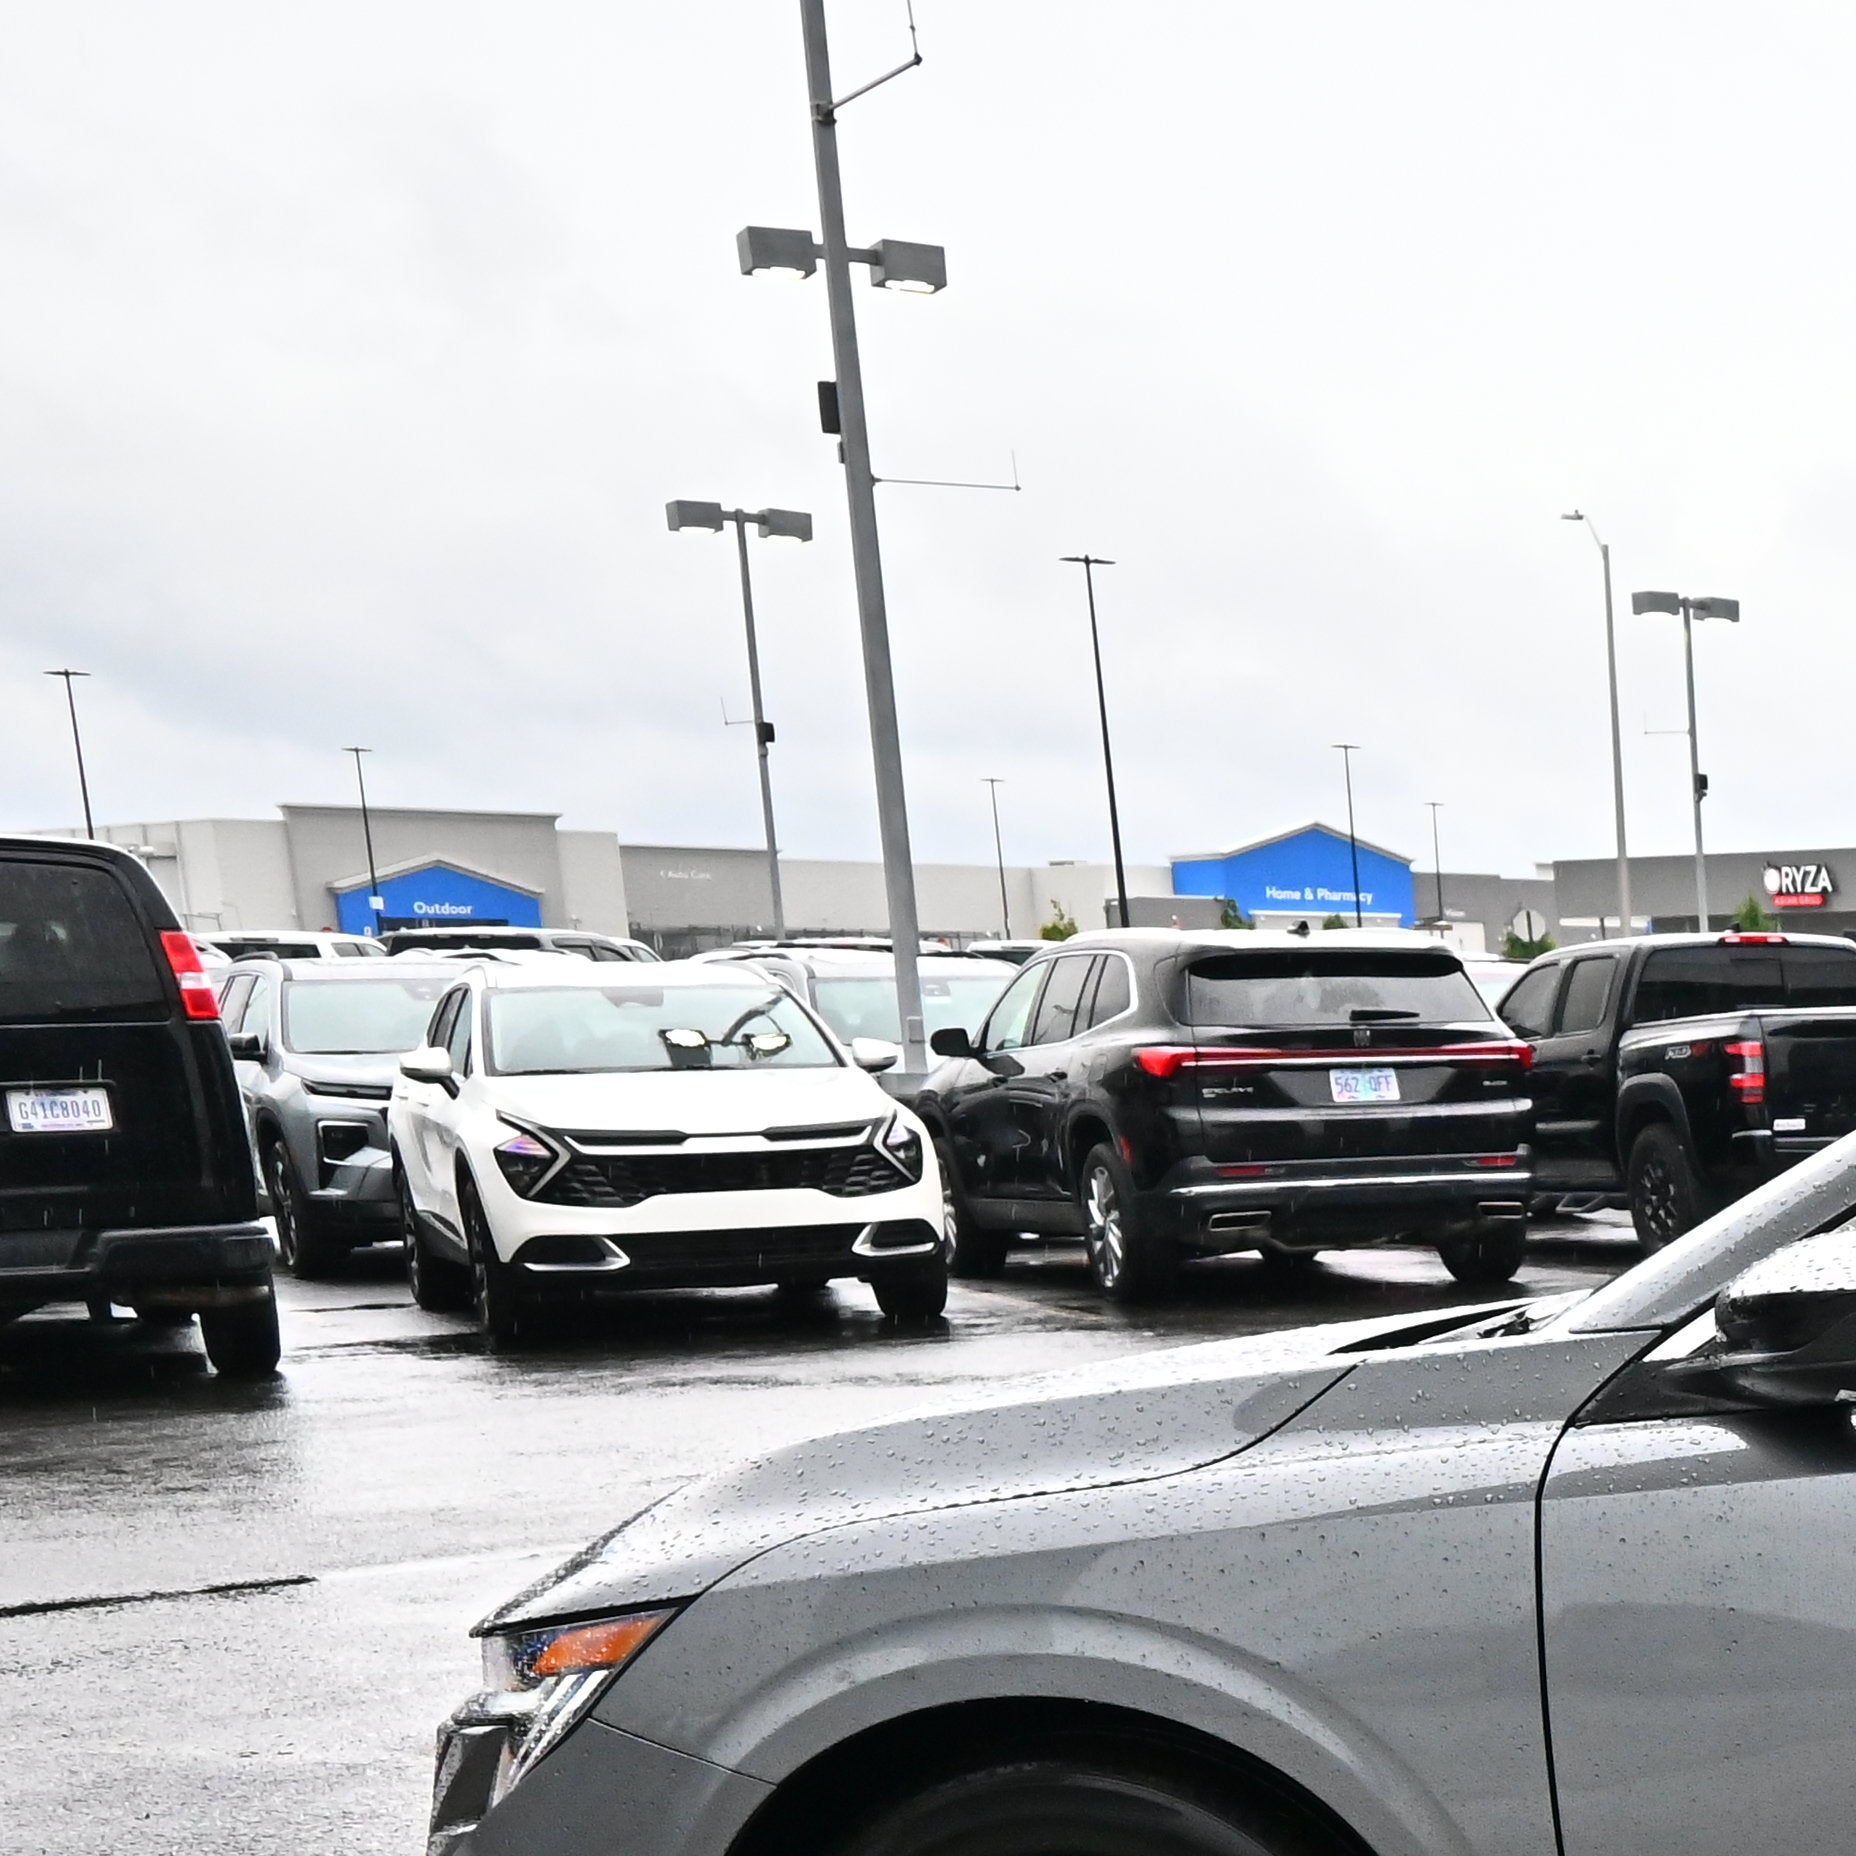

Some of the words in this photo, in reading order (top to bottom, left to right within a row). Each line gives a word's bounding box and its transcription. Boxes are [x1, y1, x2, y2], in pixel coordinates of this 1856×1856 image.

[1265, 886, 1301, 901] Home
[1303, 887, 1313, 900] &
[1316, 887, 1374, 905] Pharmcy
[413, 901, 473, 915] Outdoor
